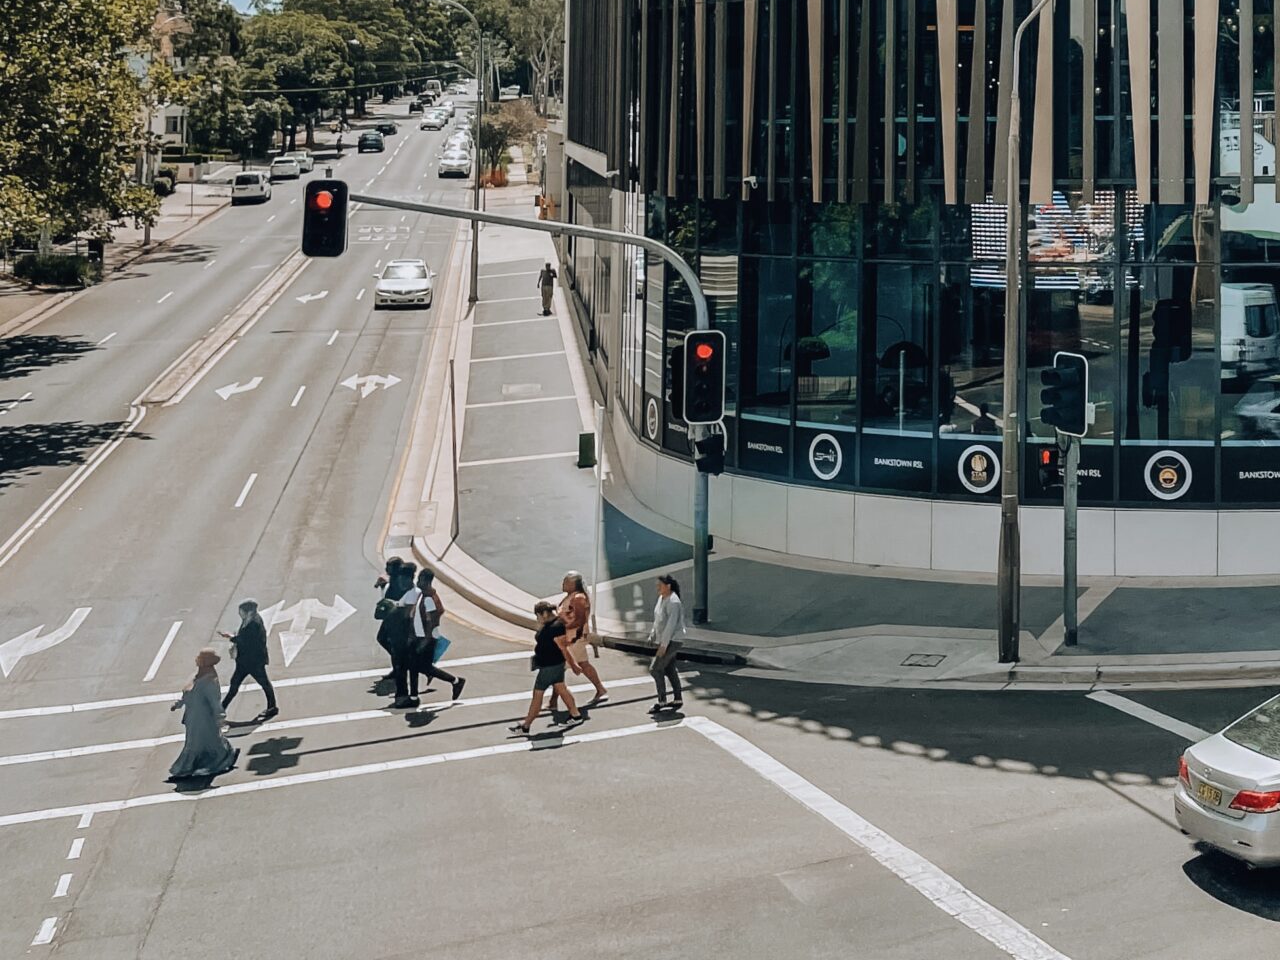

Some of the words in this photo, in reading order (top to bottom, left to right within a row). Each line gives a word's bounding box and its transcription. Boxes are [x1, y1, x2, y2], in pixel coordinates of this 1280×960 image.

[873, 457, 912, 468] BANKSTOWN
[912, 460, 924, 469] RSL
[1088, 468, 1102, 478] RSL
